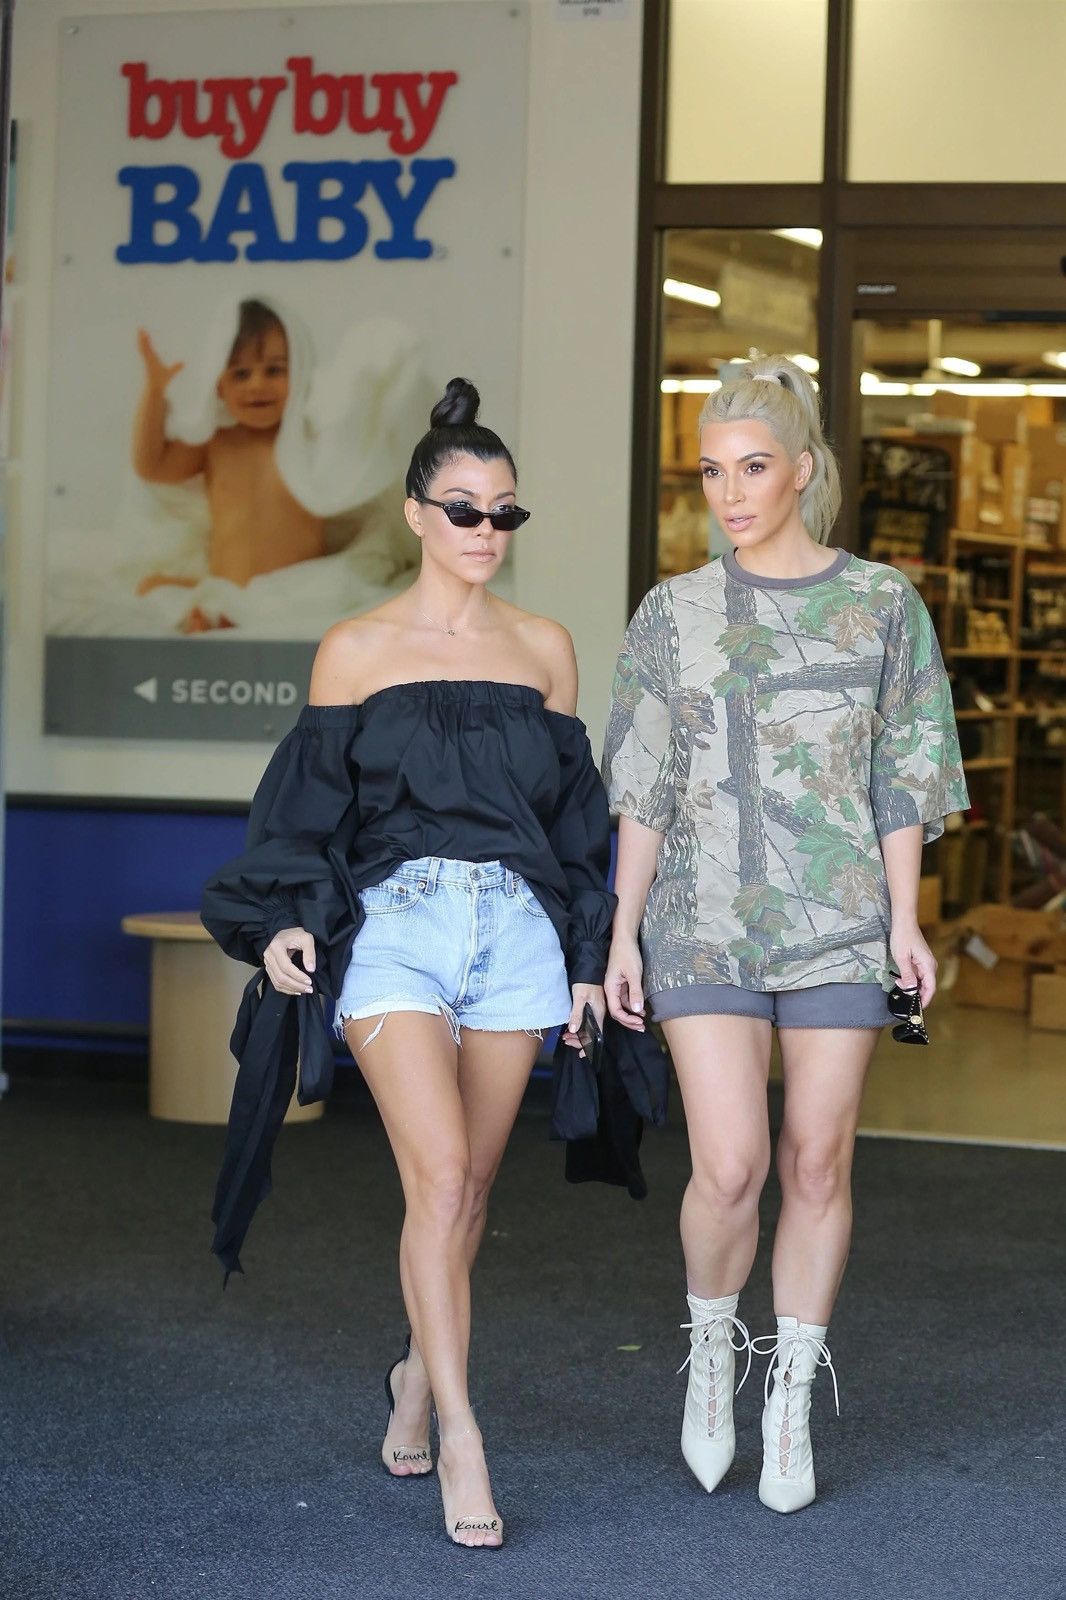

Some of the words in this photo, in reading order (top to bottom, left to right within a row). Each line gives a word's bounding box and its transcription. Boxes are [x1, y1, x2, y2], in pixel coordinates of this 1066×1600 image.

[116, 158, 456, 264] BABY
[171, 679, 298, 706] SECOND
[454, 1520, 499, 1533] Kourt
